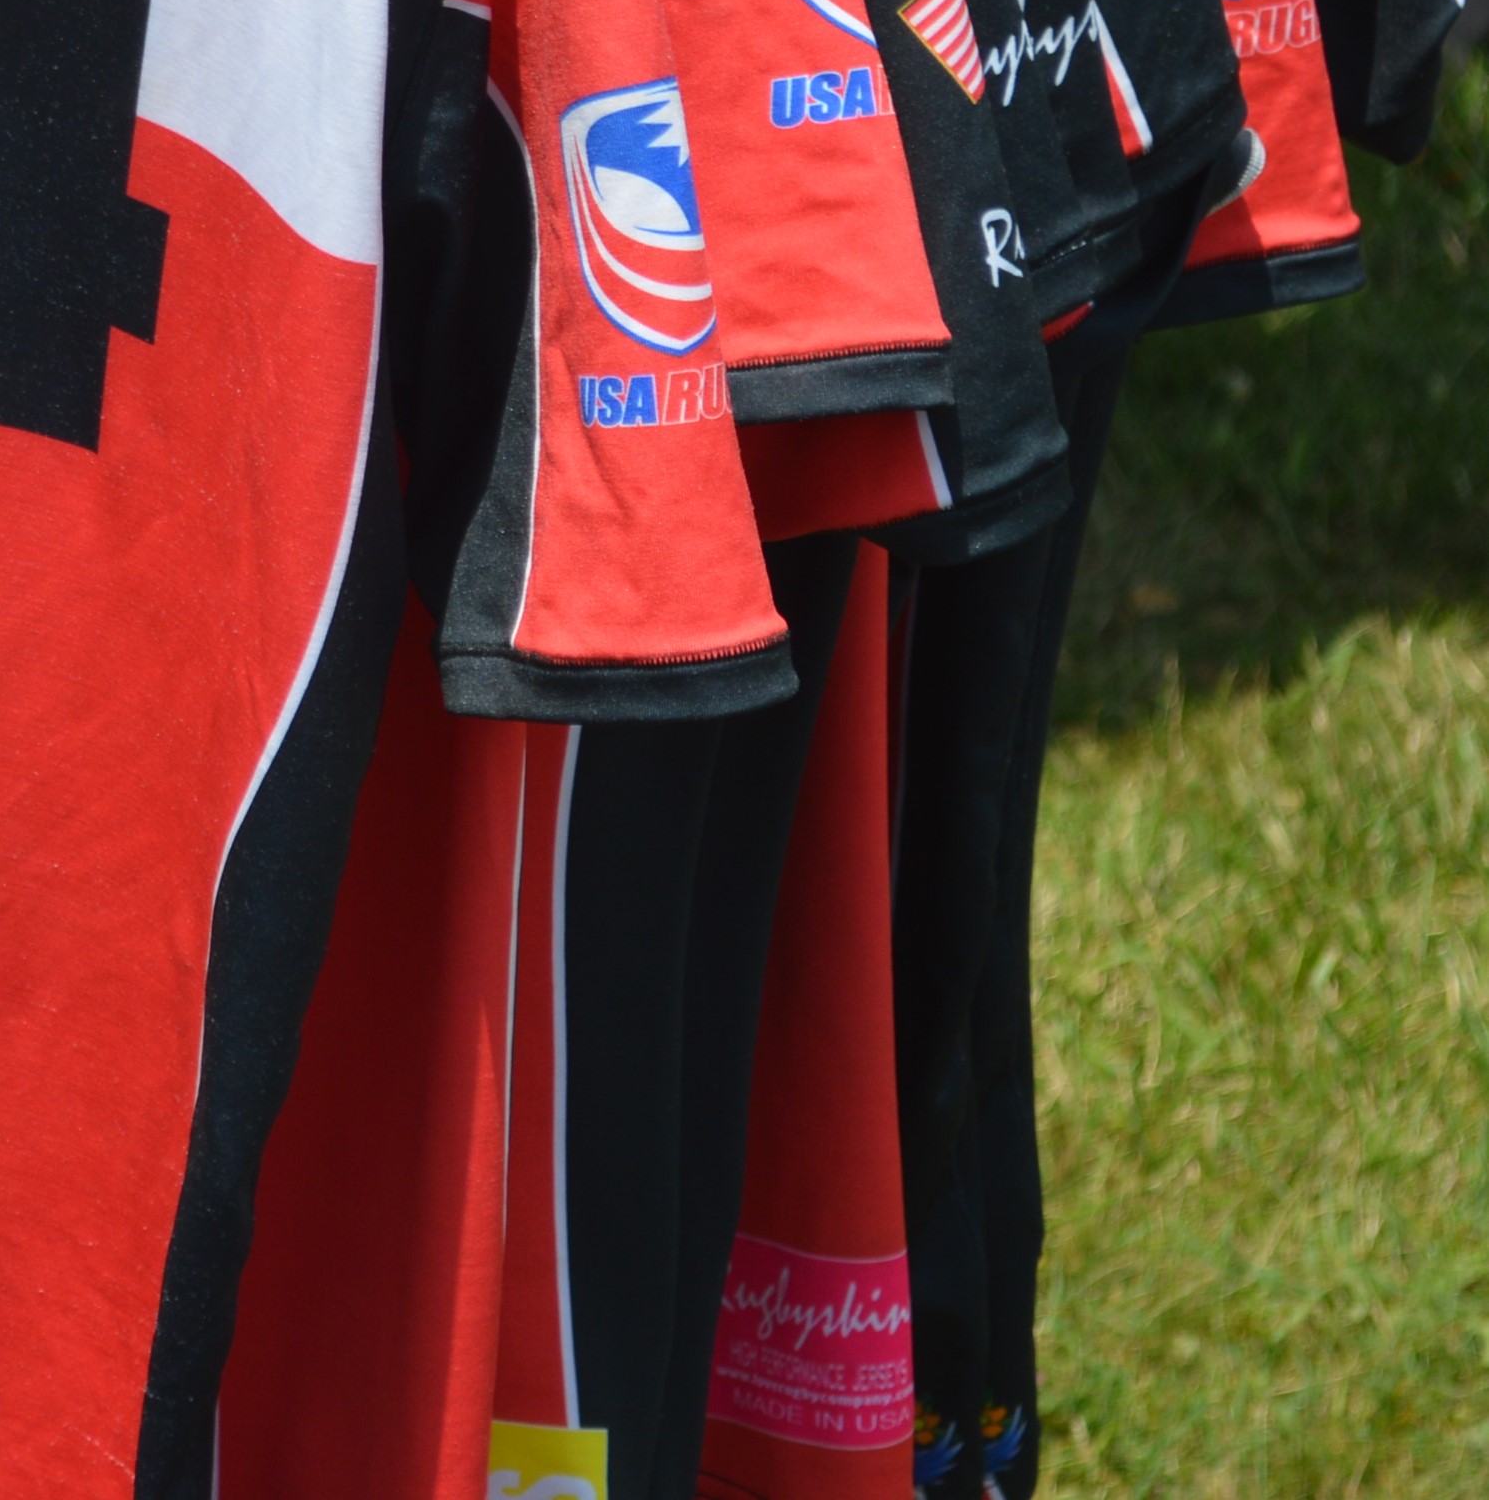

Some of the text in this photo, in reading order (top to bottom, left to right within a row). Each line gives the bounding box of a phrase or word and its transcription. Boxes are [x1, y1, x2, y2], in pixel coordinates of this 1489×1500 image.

[769, 66, 877, 129] USA
[579, 374, 659, 428] USA
[814, 1411, 844, 1432] IN
[855, 1406, 912, 1433] USA
